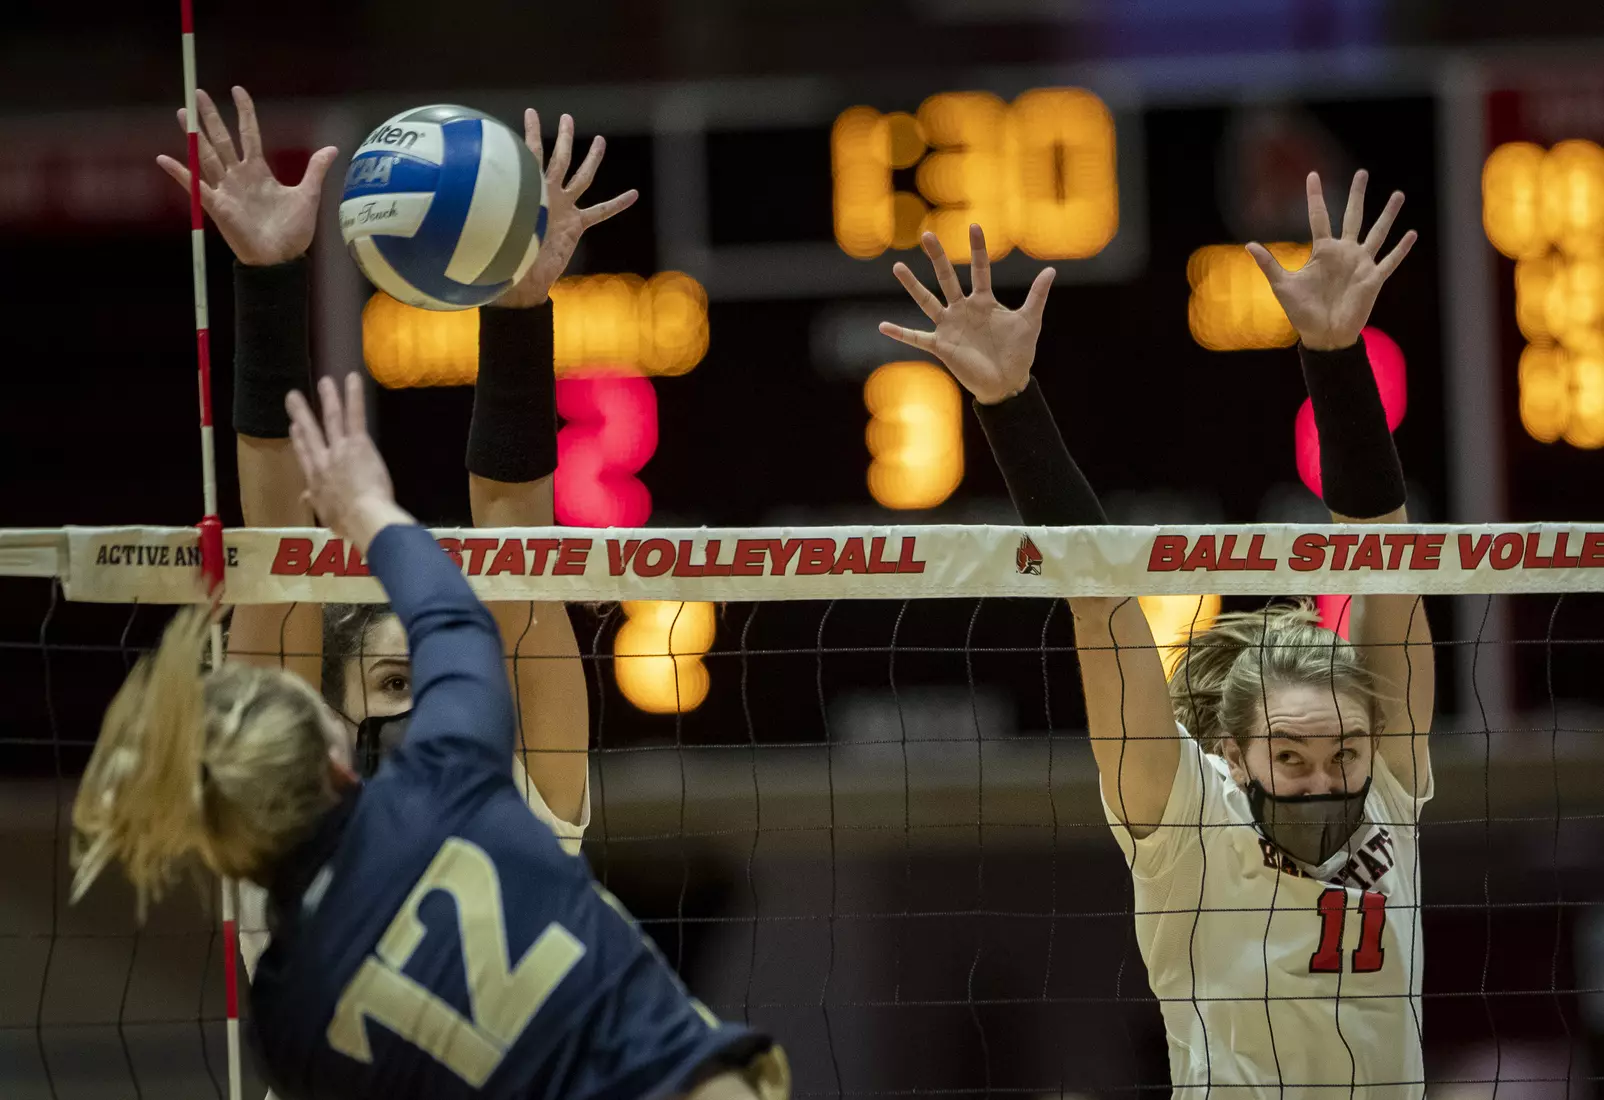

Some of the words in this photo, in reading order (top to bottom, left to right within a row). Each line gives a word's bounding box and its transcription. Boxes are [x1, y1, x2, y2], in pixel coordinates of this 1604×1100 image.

[363, 125, 418, 150] lten
[96, 544, 170, 566] ACTIVE
[174, 546, 238, 567] ANE
[270, 538, 372, 577] BAL
[606, 536, 927, 577] VOLLEYBALL
[1147, 534, 1277, 572] BALL
[1288, 533, 1447, 572] STATE
[1457, 532, 1604, 570] VOLLE
[1308, 887, 1388, 973] 11
[326, 836, 586, 1088] 12
